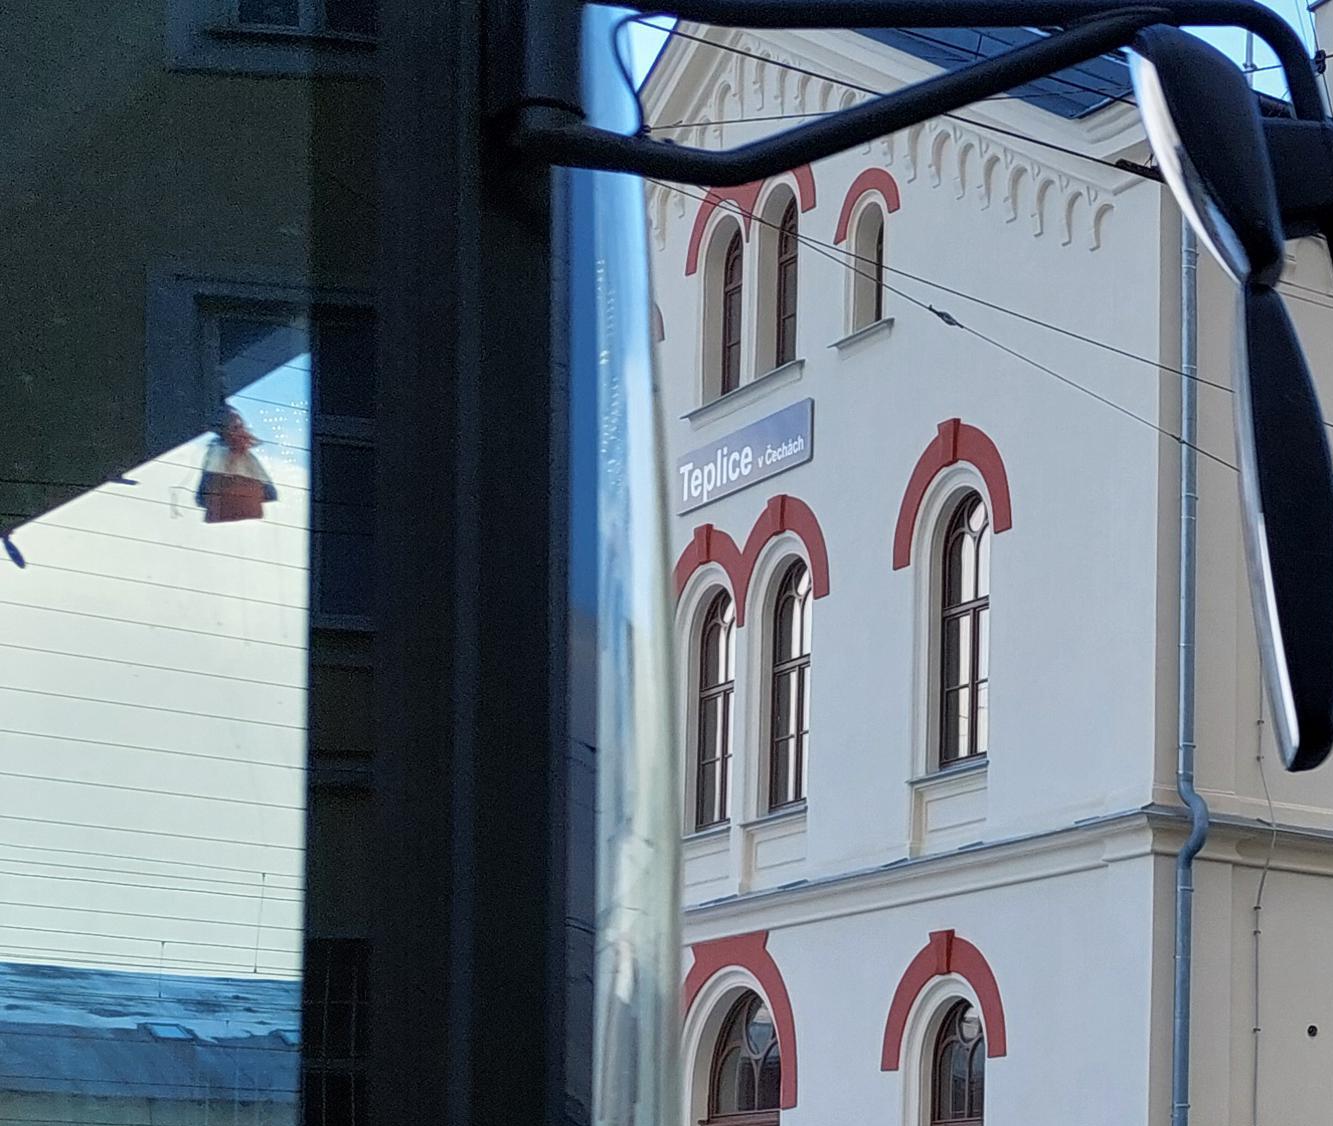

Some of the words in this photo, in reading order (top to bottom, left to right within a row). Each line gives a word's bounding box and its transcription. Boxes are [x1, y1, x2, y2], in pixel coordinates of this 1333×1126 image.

[680, 445, 752, 502] Teplice
[758, 455, 764, 468] v
[765, 434, 804, 465] Čechách
